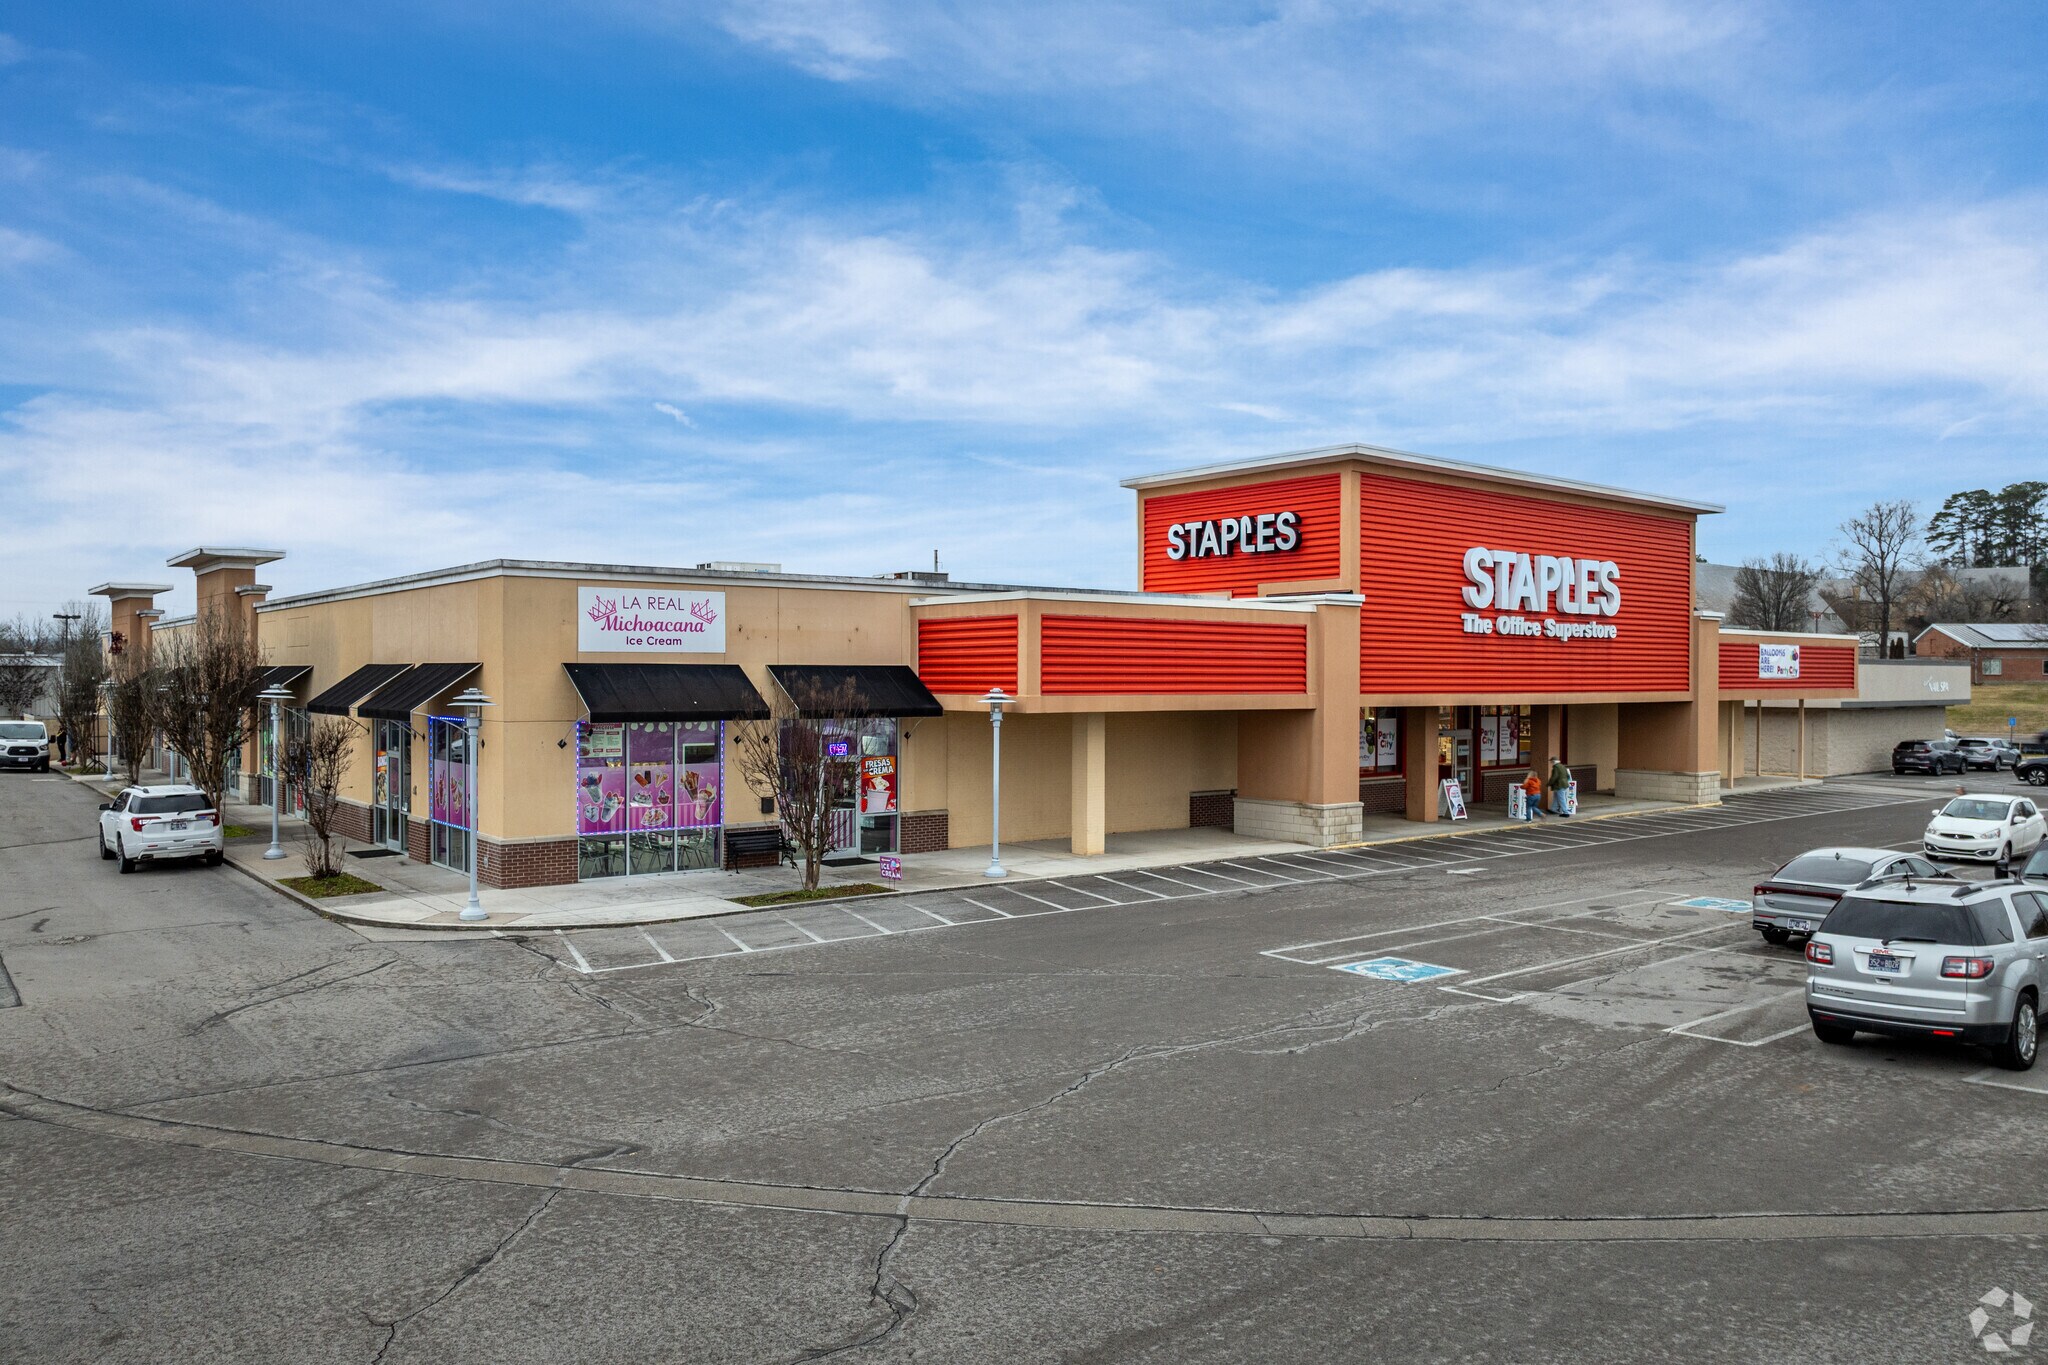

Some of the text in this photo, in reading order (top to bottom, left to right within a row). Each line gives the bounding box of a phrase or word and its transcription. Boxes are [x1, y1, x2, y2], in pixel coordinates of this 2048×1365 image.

[1166, 511, 1298, 560] STAPLES
[1462, 546, 1621, 617] STAPLES
[622, 596, 685, 611] LA REAL
[600, 614, 706, 633] Michoacana
[1461, 613, 1618, 642] The Office Superstore
[626, 636, 682, 646] Ice Cream
[1760, 656, 1770, 665] ARE
[1776, 665, 1798, 677] Party City
[1378, 730, 1395, 742] Party
[1482, 736, 1494, 747] City
[1380, 739, 1393, 750] City
[865, 758, 891, 769] FRESAS
[869, 765, 894, 776] CREMA
[1567, 782, 1576, 814] Party City
[881, 862, 890, 870] ICE
[881, 869, 901, 879] CREAM
